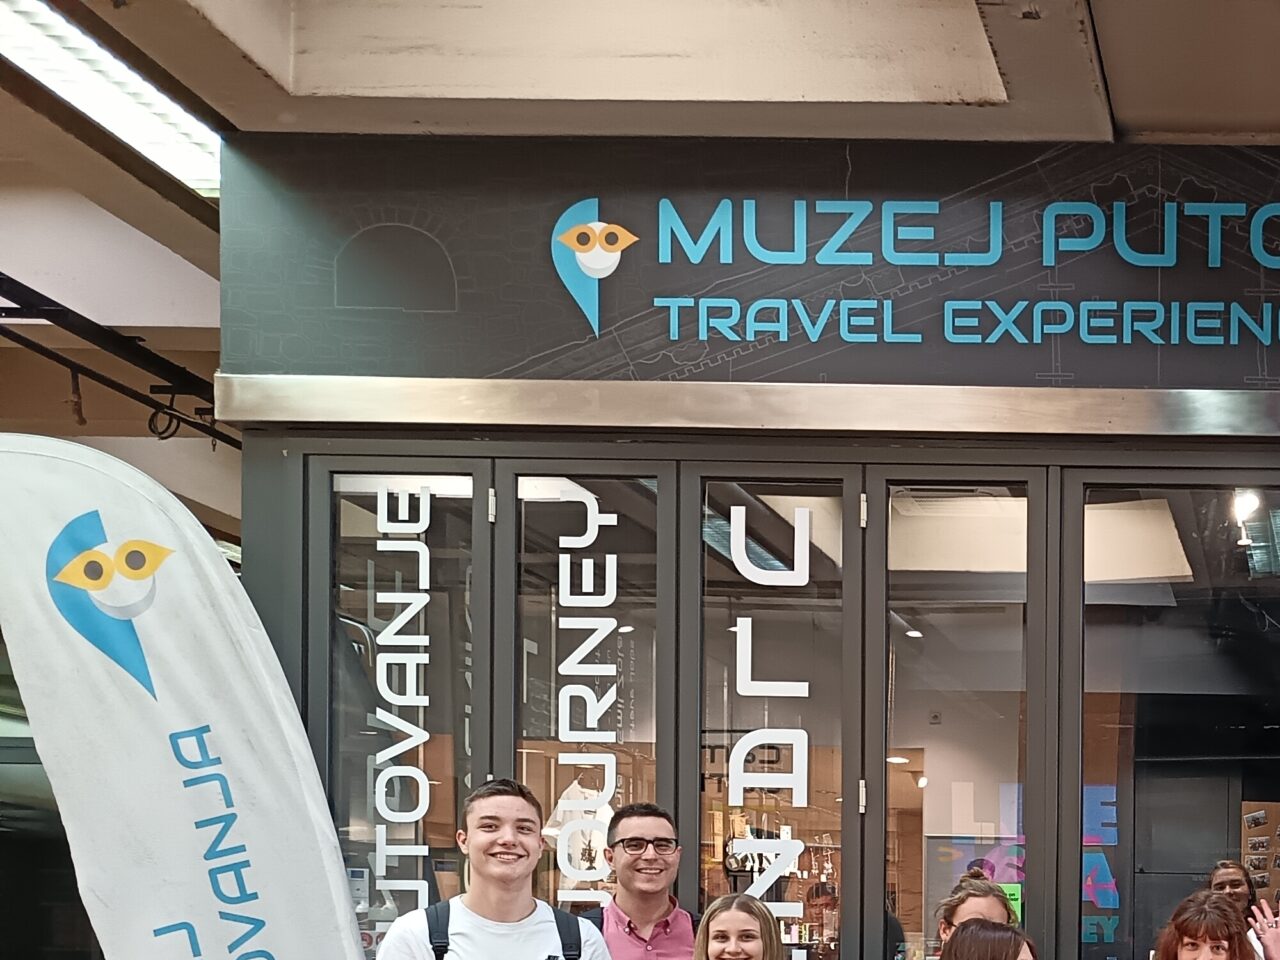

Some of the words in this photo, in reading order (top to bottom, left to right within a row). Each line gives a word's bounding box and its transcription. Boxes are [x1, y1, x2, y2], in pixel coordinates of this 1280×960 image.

[659, 199, 1004, 266] MUZEJ
[653, 296, 924, 342] TRAVEL
[375, 486, 431, 916] UTOVANJE
